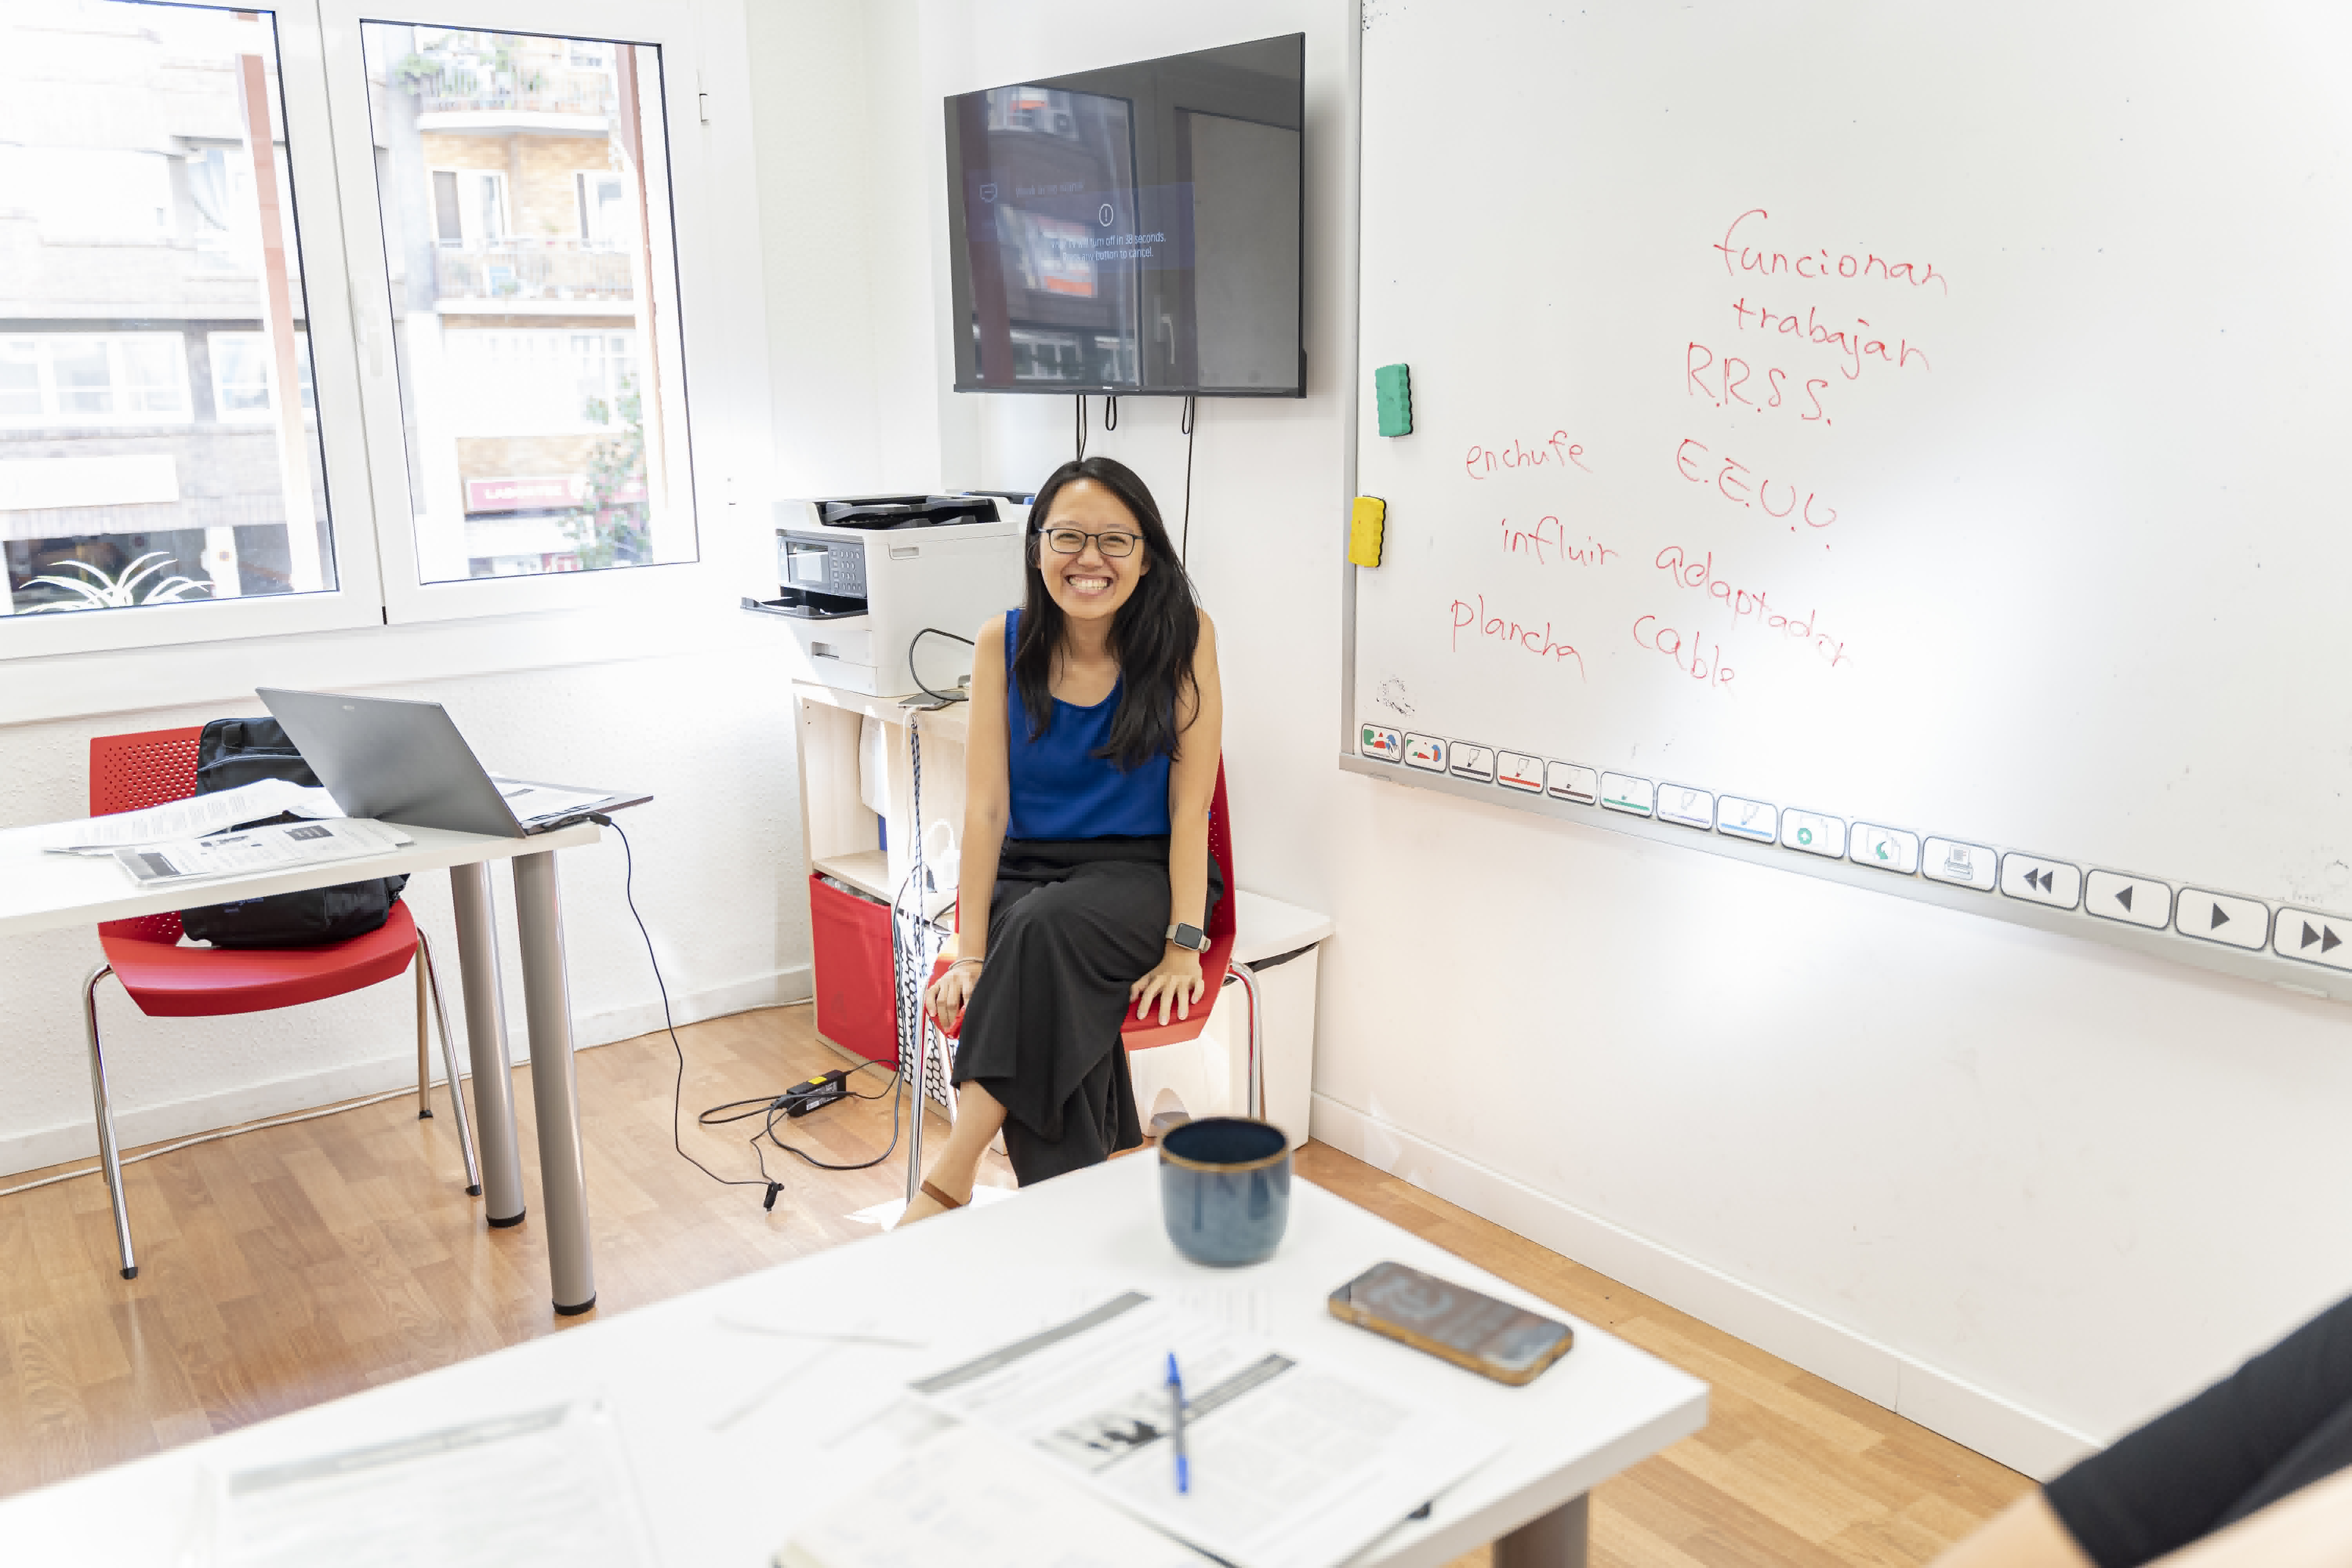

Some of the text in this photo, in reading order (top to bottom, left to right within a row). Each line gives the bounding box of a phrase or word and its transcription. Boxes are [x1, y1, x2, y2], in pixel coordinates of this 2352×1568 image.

[1090, 237, 1104, 246] turn
[1107, 235, 1116, 246] off
[1117, 235, 1123, 245] in
[1134, 232, 1167, 244] seconds.
[1094, 251, 1118, 261] button
[1120, 250, 1127, 260] to
[1129, 246, 1154, 258] cancel.
[1713, 207, 1950, 296] funcionan
[1732, 297, 1930, 380] trabajan
[1465, 429, 1593, 481] enchufe
[1501, 514, 1621, 568] influir
[1655, 545, 1854, 668] adaptador
